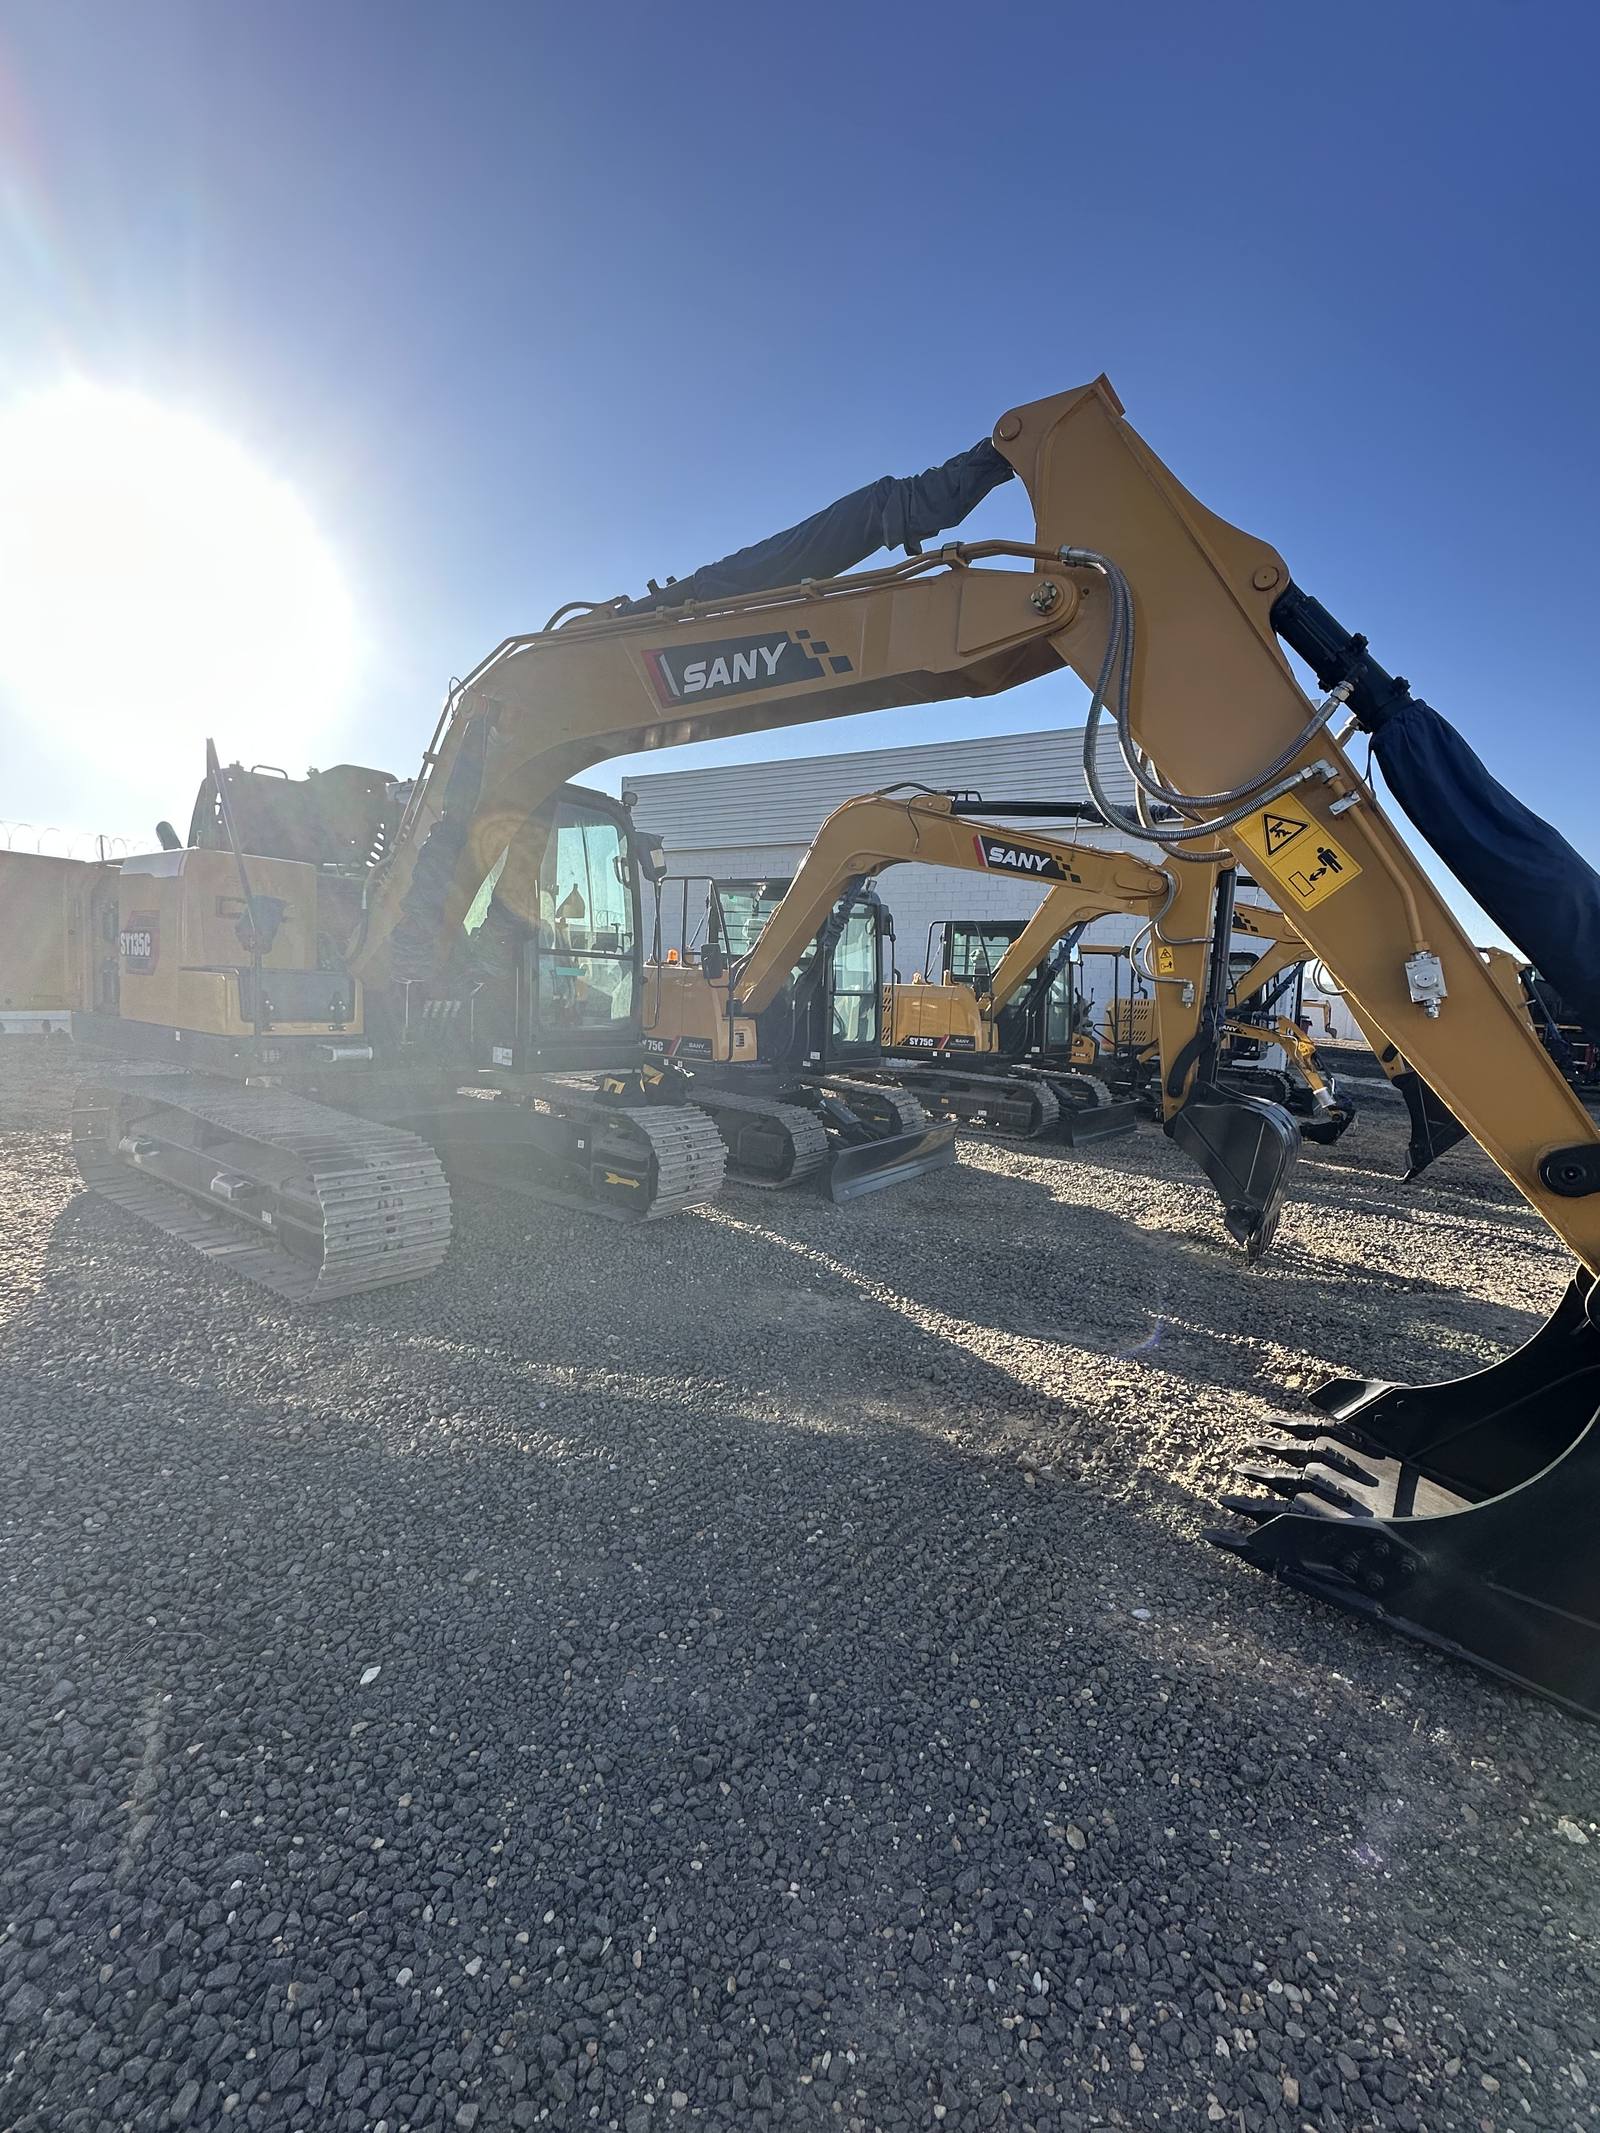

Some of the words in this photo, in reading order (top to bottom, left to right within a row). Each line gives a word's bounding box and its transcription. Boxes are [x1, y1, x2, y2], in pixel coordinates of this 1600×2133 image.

[683, 641, 788, 694] SANY
[988, 846, 1051, 872] SANY
[647, 1040, 664, 1052] 75C
[909, 1037, 919, 1046] SY
[919, 1038, 934, 1047] 75C
